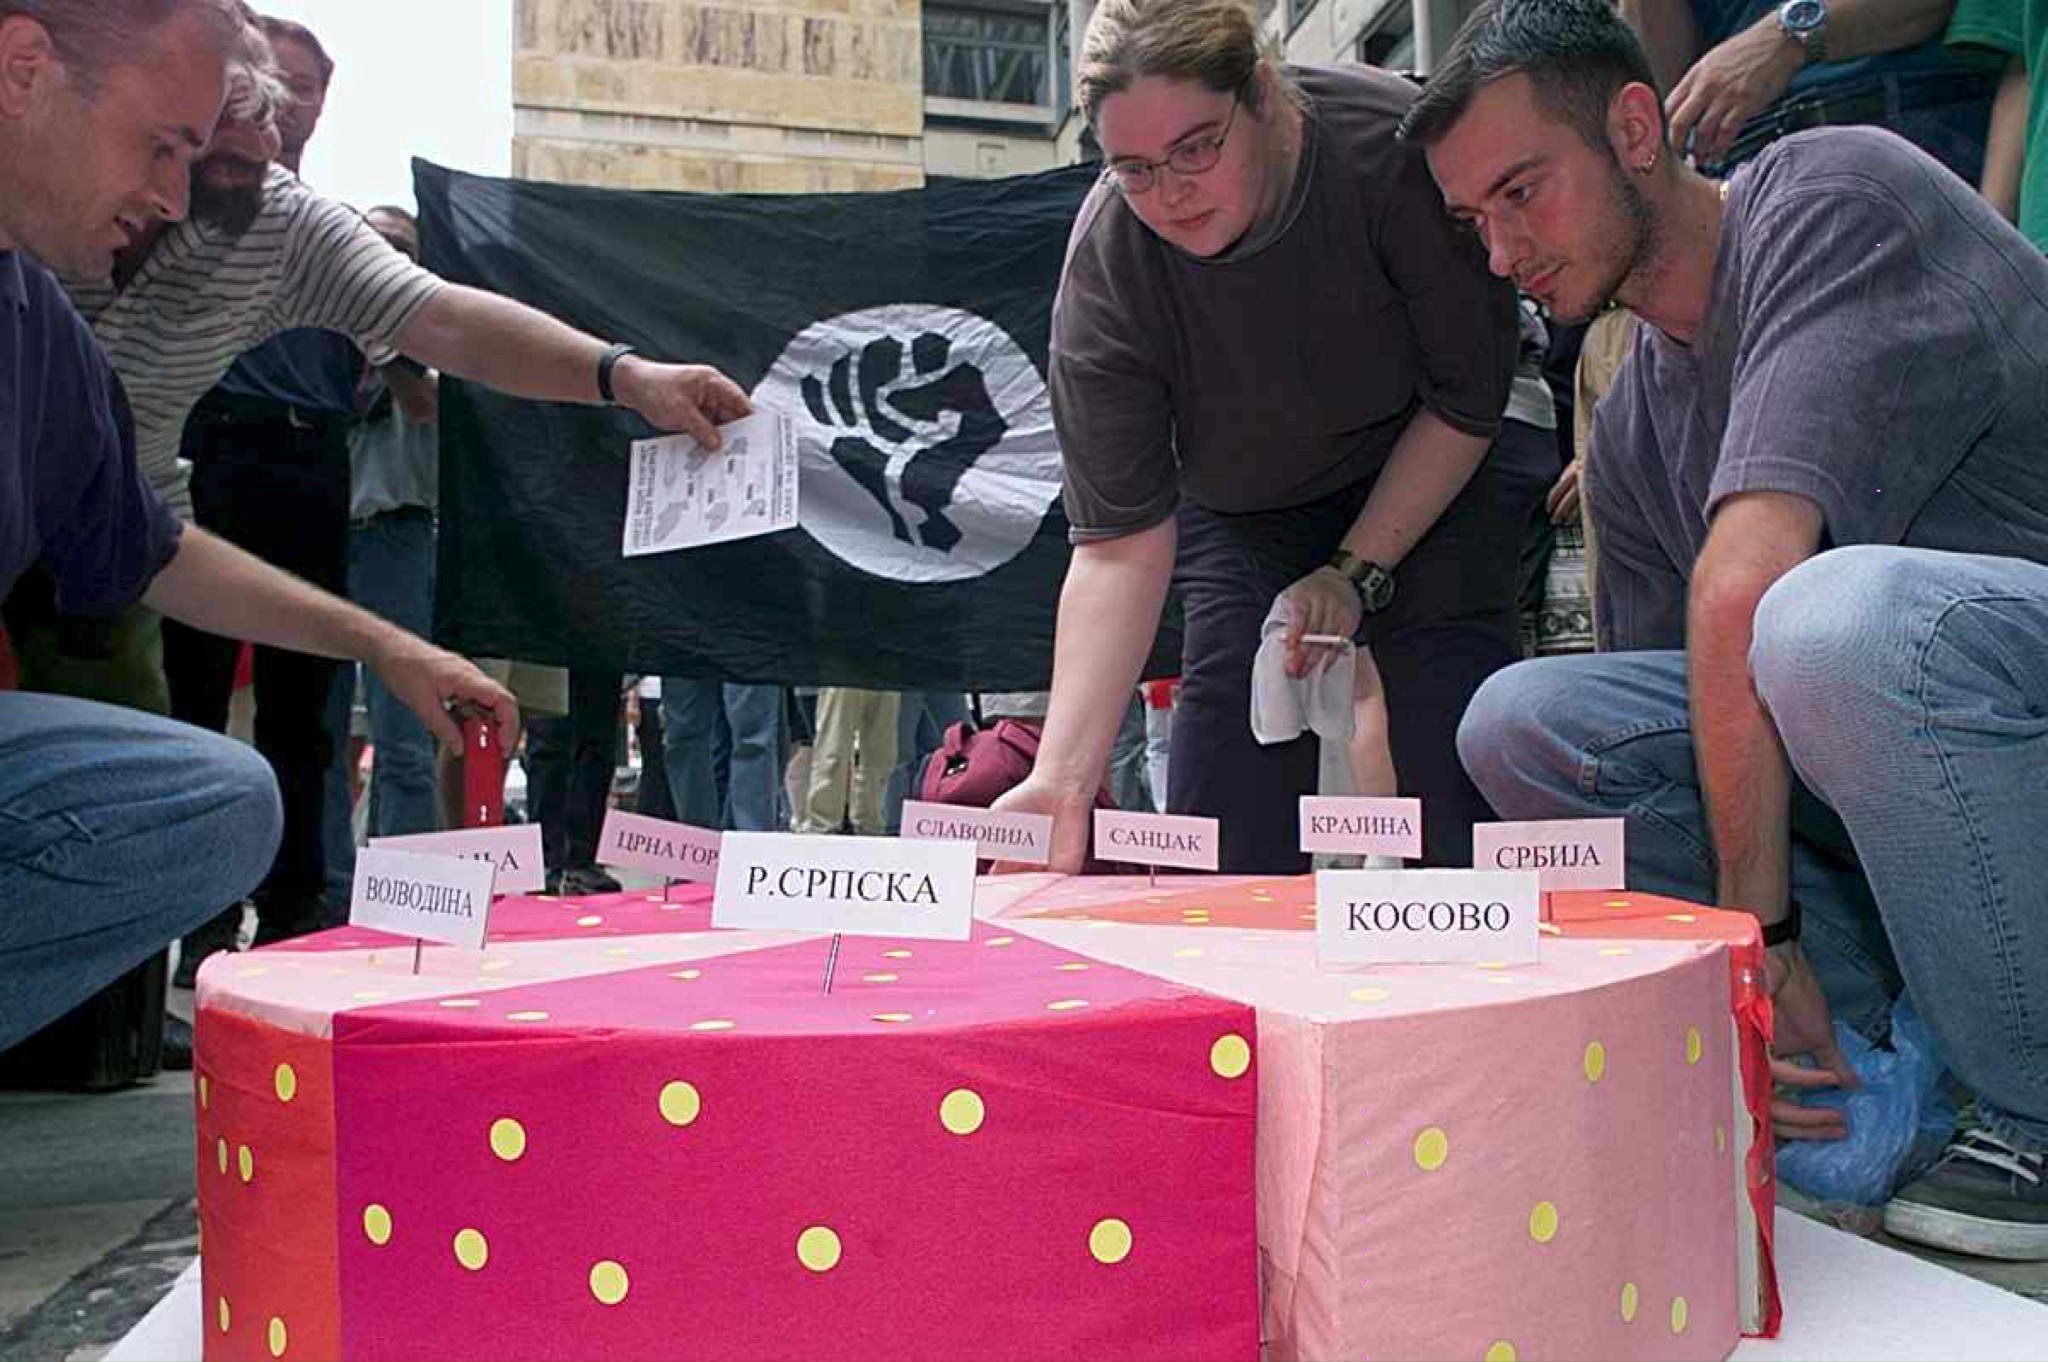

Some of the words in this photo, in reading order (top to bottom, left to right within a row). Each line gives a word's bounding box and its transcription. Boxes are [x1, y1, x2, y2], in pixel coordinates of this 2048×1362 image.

[916, 818, 1035, 848] СЛАВОНИЈА
[1109, 828, 1202, 852] САНЏАК
[1311, 815, 1412, 836] КРАЈИНА
[617, 830, 674, 859] ЦРНА
[680, 843, 719, 866] ГОР
[1495, 845, 1601, 869] СРБИЈА
[366, 876, 473, 917] ВОЈВОДИНА
[747, 866, 939, 904] Р.СРПСКА
[1348, 902, 1510, 931] КОСОВО
